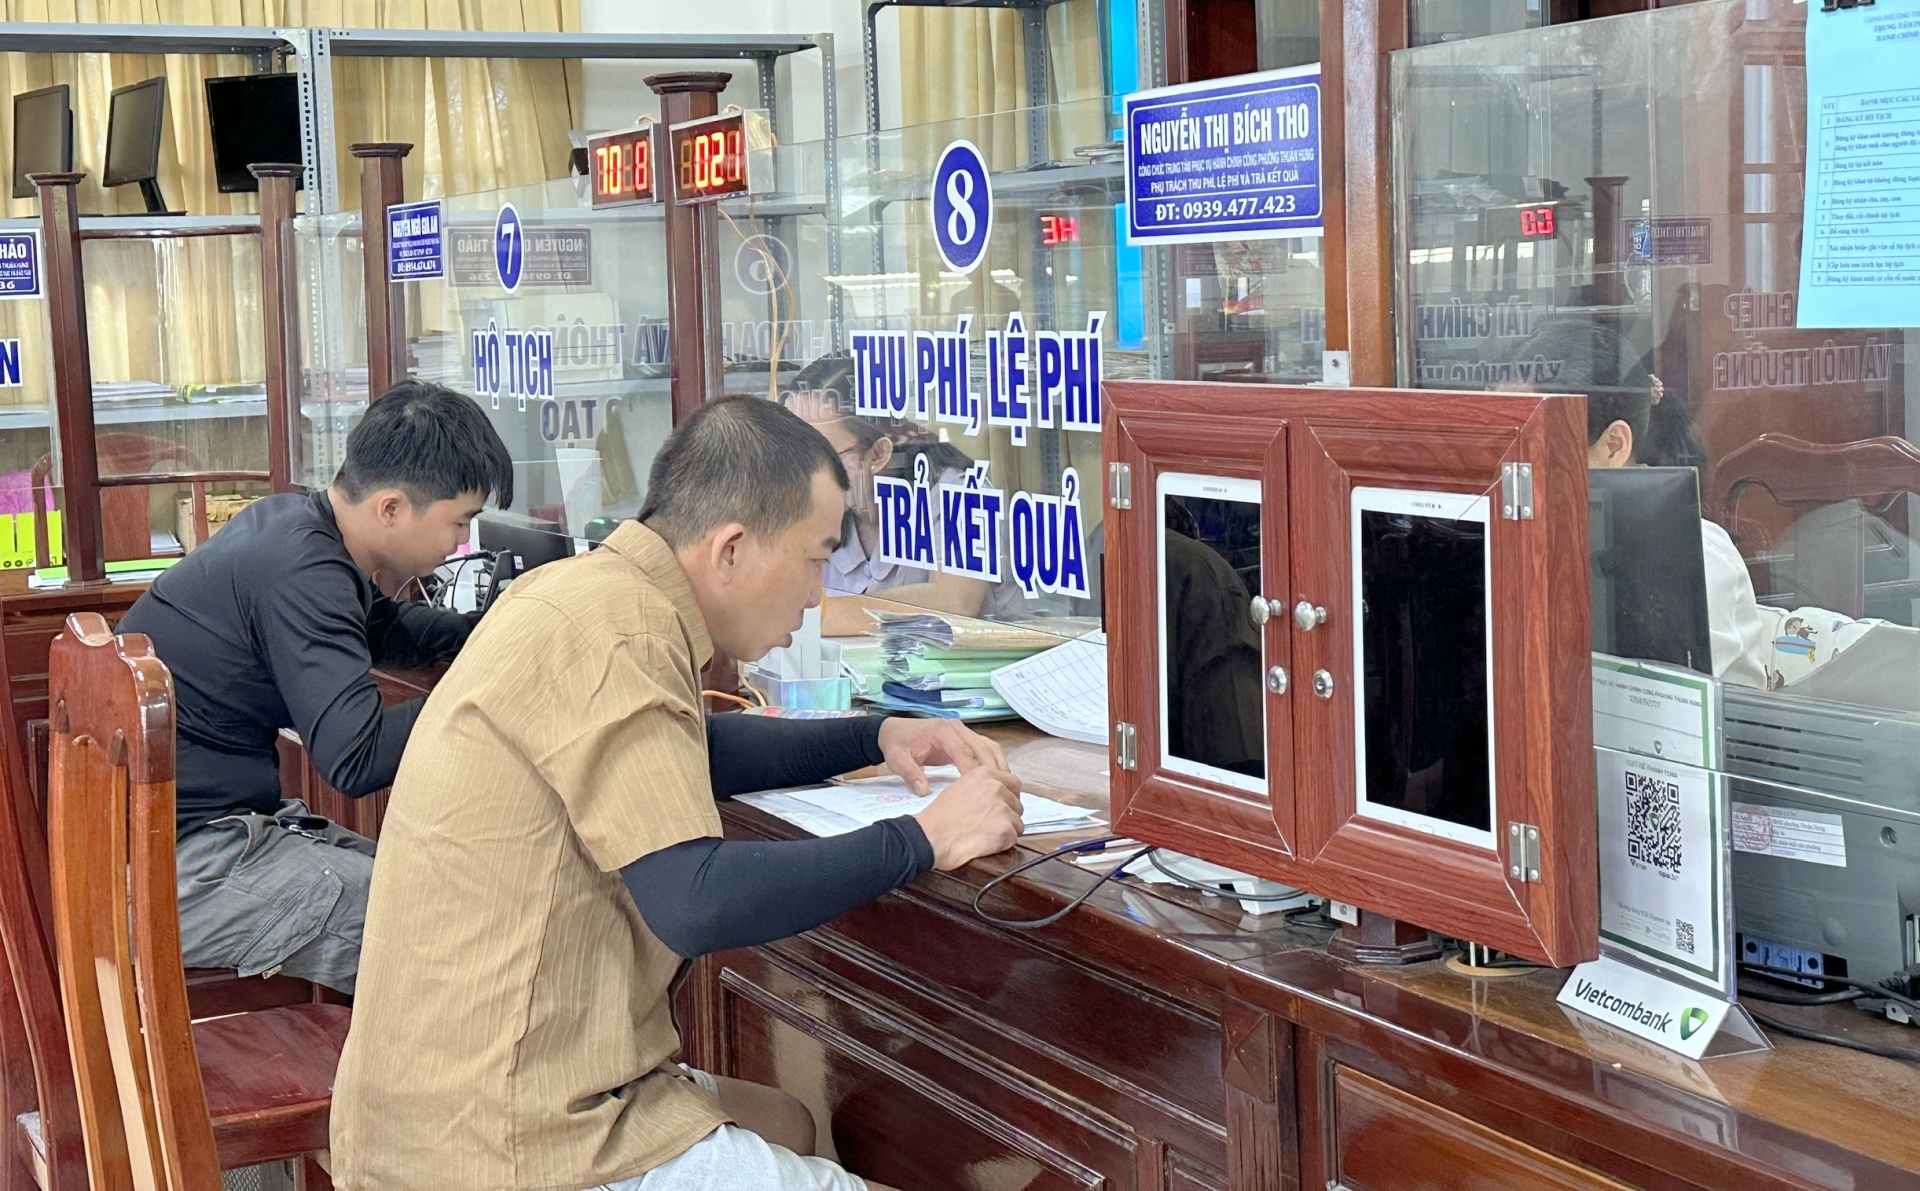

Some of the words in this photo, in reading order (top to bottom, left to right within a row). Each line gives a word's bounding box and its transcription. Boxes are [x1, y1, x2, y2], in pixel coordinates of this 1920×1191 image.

[1140, 107, 1200, 155] NGUYỄN
[1204, 114, 1230, 154] THỊ
[1233, 104, 1274, 145] BÍCH
[948, 168, 976, 246] 8
[1155, 202, 1180, 222] ĐT:
[1183, 195, 1296, 220] 0939.477.423
[502, 222, 515, 275] 7
[474, 319, 500, 409] HỘ
[506, 331, 554, 411] TỊCH
[851, 333, 907, 415] THU
[915, 317, 980, 433] PHÍ,
[986, 315, 1030, 443] LỆ
[1036, 315, 1104, 428] PHÍ
[876, 456, 936, 568] TRẢ
[942, 464, 1002, 580] KẾT
[1011, 471, 1088, 596] QUẢ
[1575, 978, 1674, 1033] Vietcombank
